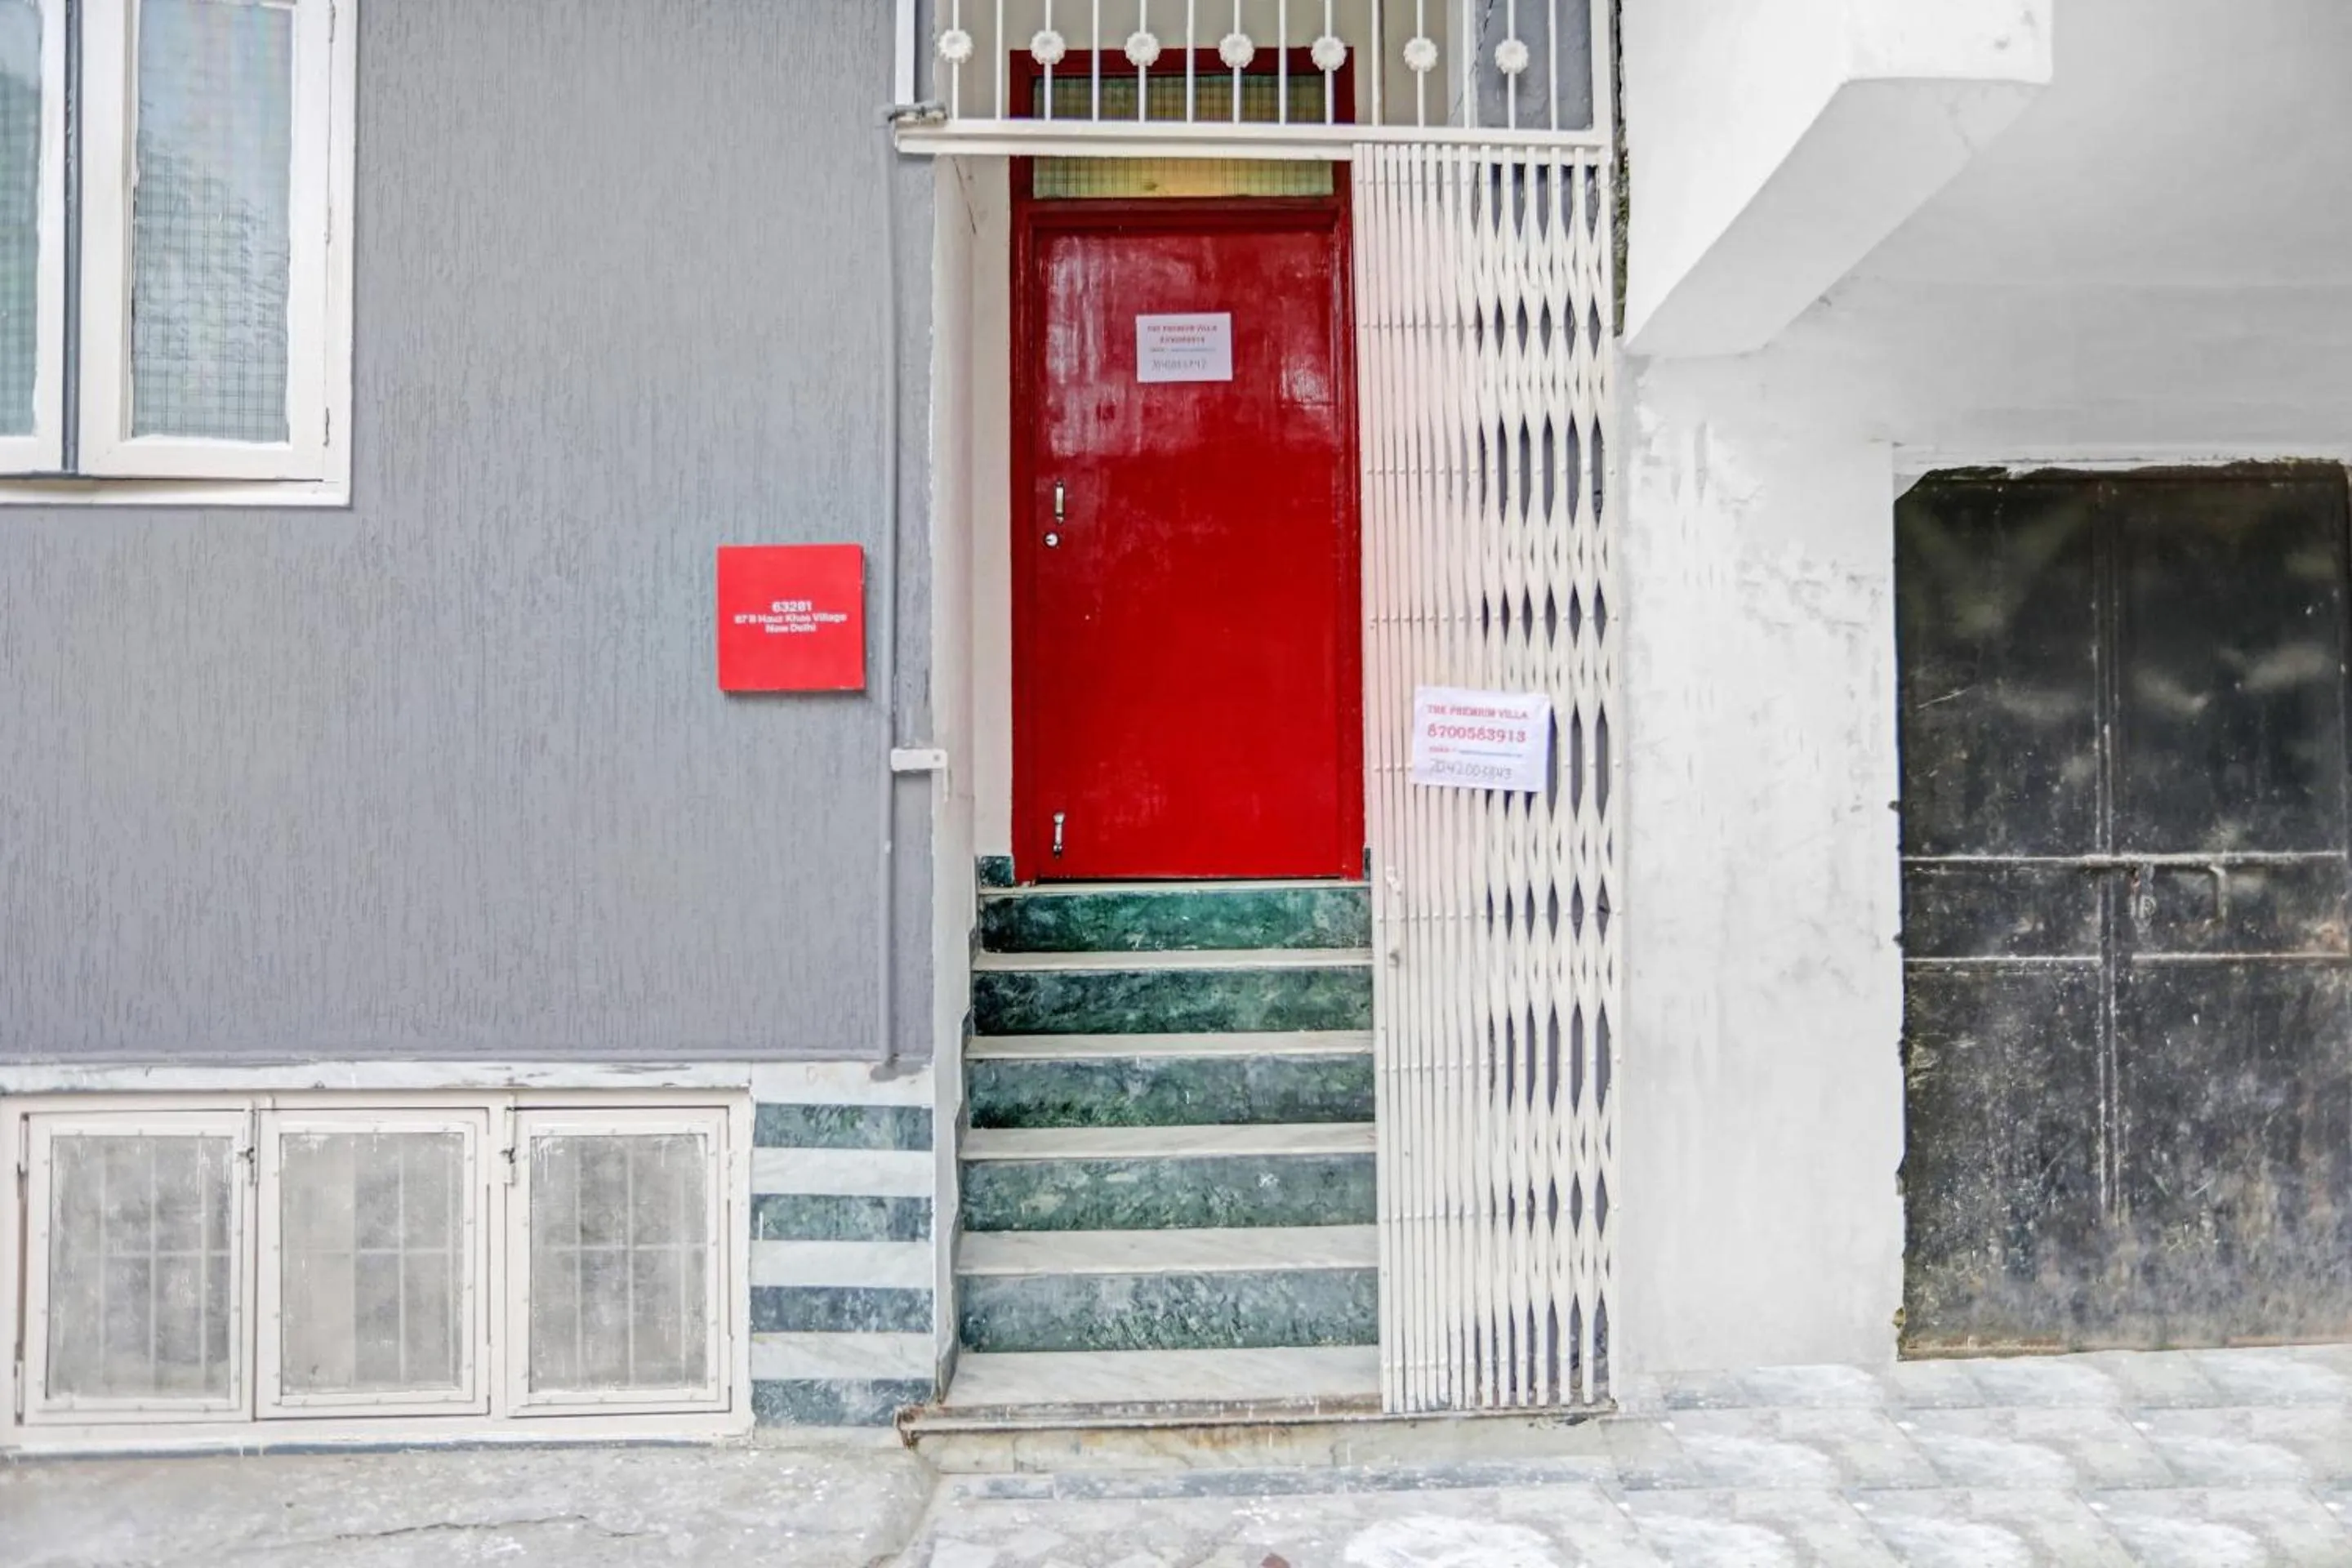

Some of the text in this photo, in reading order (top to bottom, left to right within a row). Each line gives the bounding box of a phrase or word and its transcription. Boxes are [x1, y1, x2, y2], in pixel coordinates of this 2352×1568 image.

[758, 614, 784, 623] Hauz
[786, 613, 811, 623] Khas
[813, 612, 848, 623] Village
[765, 623, 817, 634] New Delhi
[1427, 704, 1529, 719] THE PREMIUM VILLA
